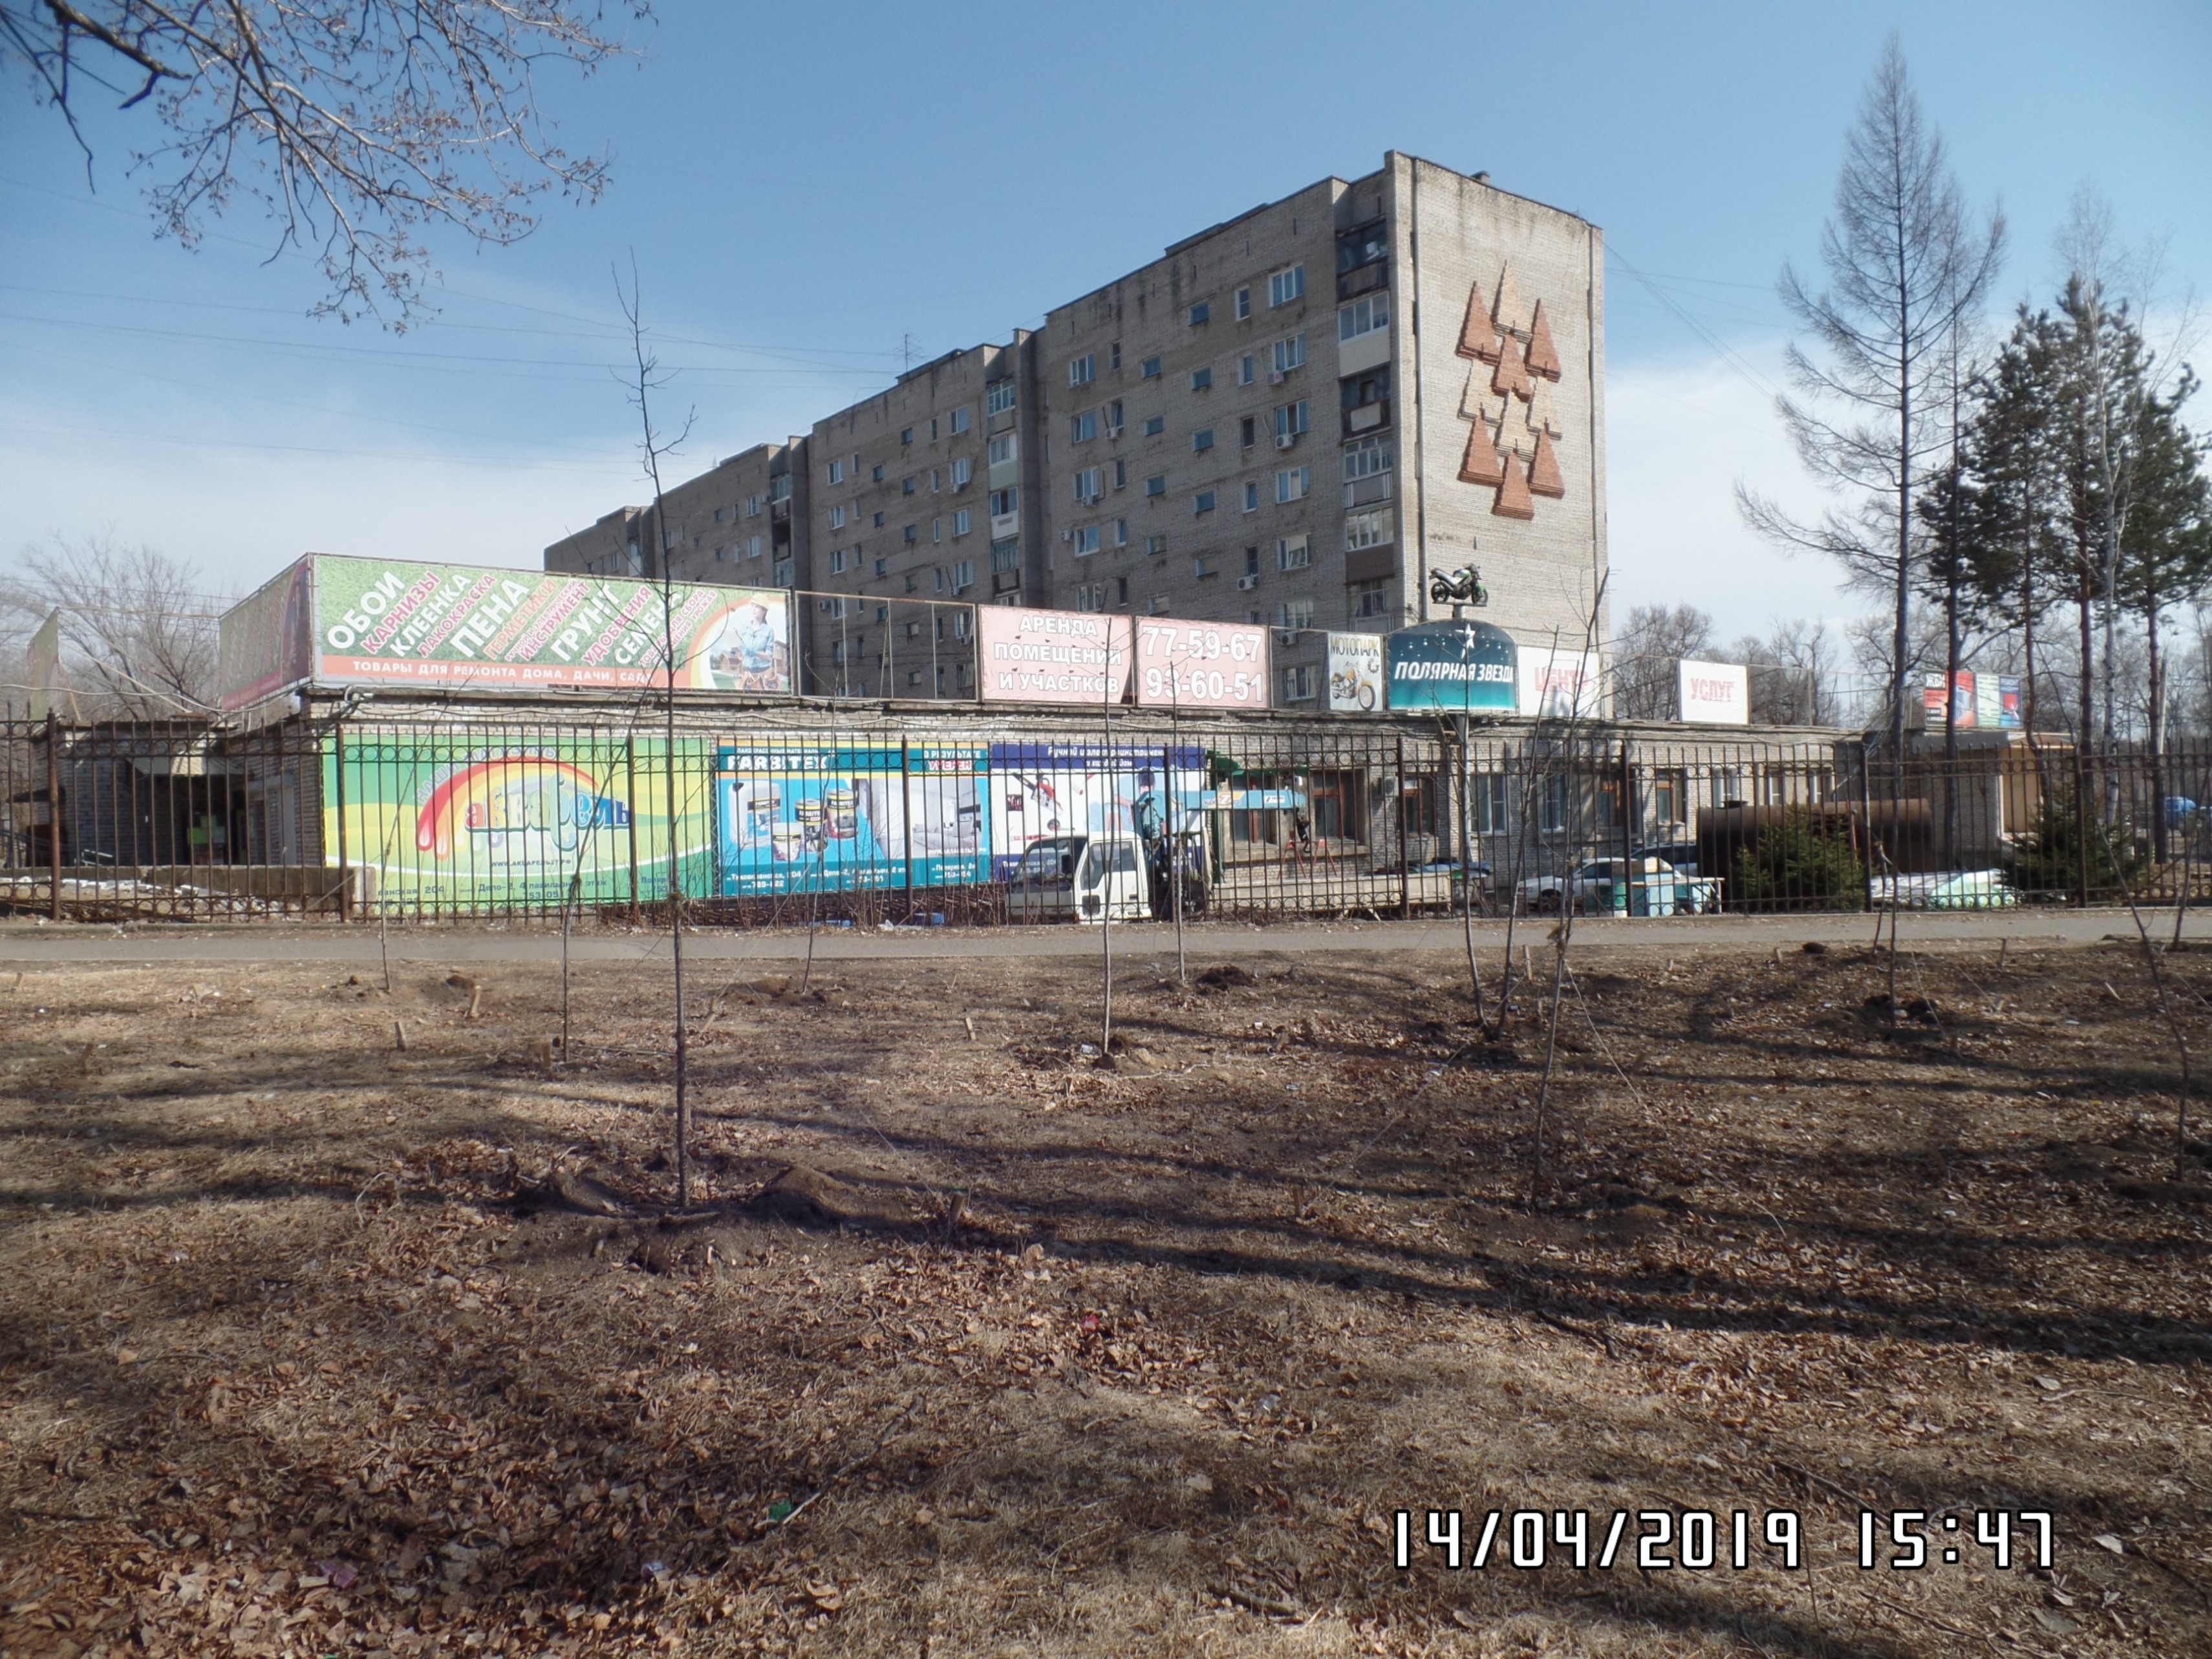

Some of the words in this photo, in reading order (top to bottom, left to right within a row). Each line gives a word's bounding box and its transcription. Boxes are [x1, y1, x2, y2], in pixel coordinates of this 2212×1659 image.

[327, 570, 405, 648] ОБОИ
[360, 570, 442, 655] КАРНИЗЫ
[389, 573, 472, 658] КЛЕЕНКА
[416, 573, 497, 659] ЛАКОКРАСКА
[449, 579, 530, 658] ПЕНА
[483, 577, 560, 660] ГЕРМЕТИКИ
[680, 589, 705, 617] СБОРА
[689, 589, 718, 621] УРОЖАЯ
[518, 580, 590, 661] ИНСТРУМЕНТ
[551, 584, 621, 662] ГРУНТ
[1019, 614, 1097, 639] АРЕНДА
[994, 642, 1122, 667] ПОМЕЩЕНИЙ
[1142, 626, 1263, 663] 77-59-67
[1329, 636, 1379, 658] МОТОПАРК
[352, 660, 412, 673] ТОВАРЫ
[418, 663, 447, 675] ДЛЯ
[454, 665, 517, 678] РЕМОНТА
[522, 668, 567, 680] ДОМА,
[573, 670, 614, 682] ДАЧИ,
[999, 673, 1013, 690] И
[1017, 673, 1119, 694] УЧАСТКОВ
[1145, 667, 1263, 702] 93-60-51
[1395, 661, 1476, 681] ПОЛЯРНАЯ
[1477, 663, 1514, 683] ЗВЕЗДА
[1534, 667, 1589, 696] ЦЕНТР
[1690, 678, 1734, 702] УСЛУГ
